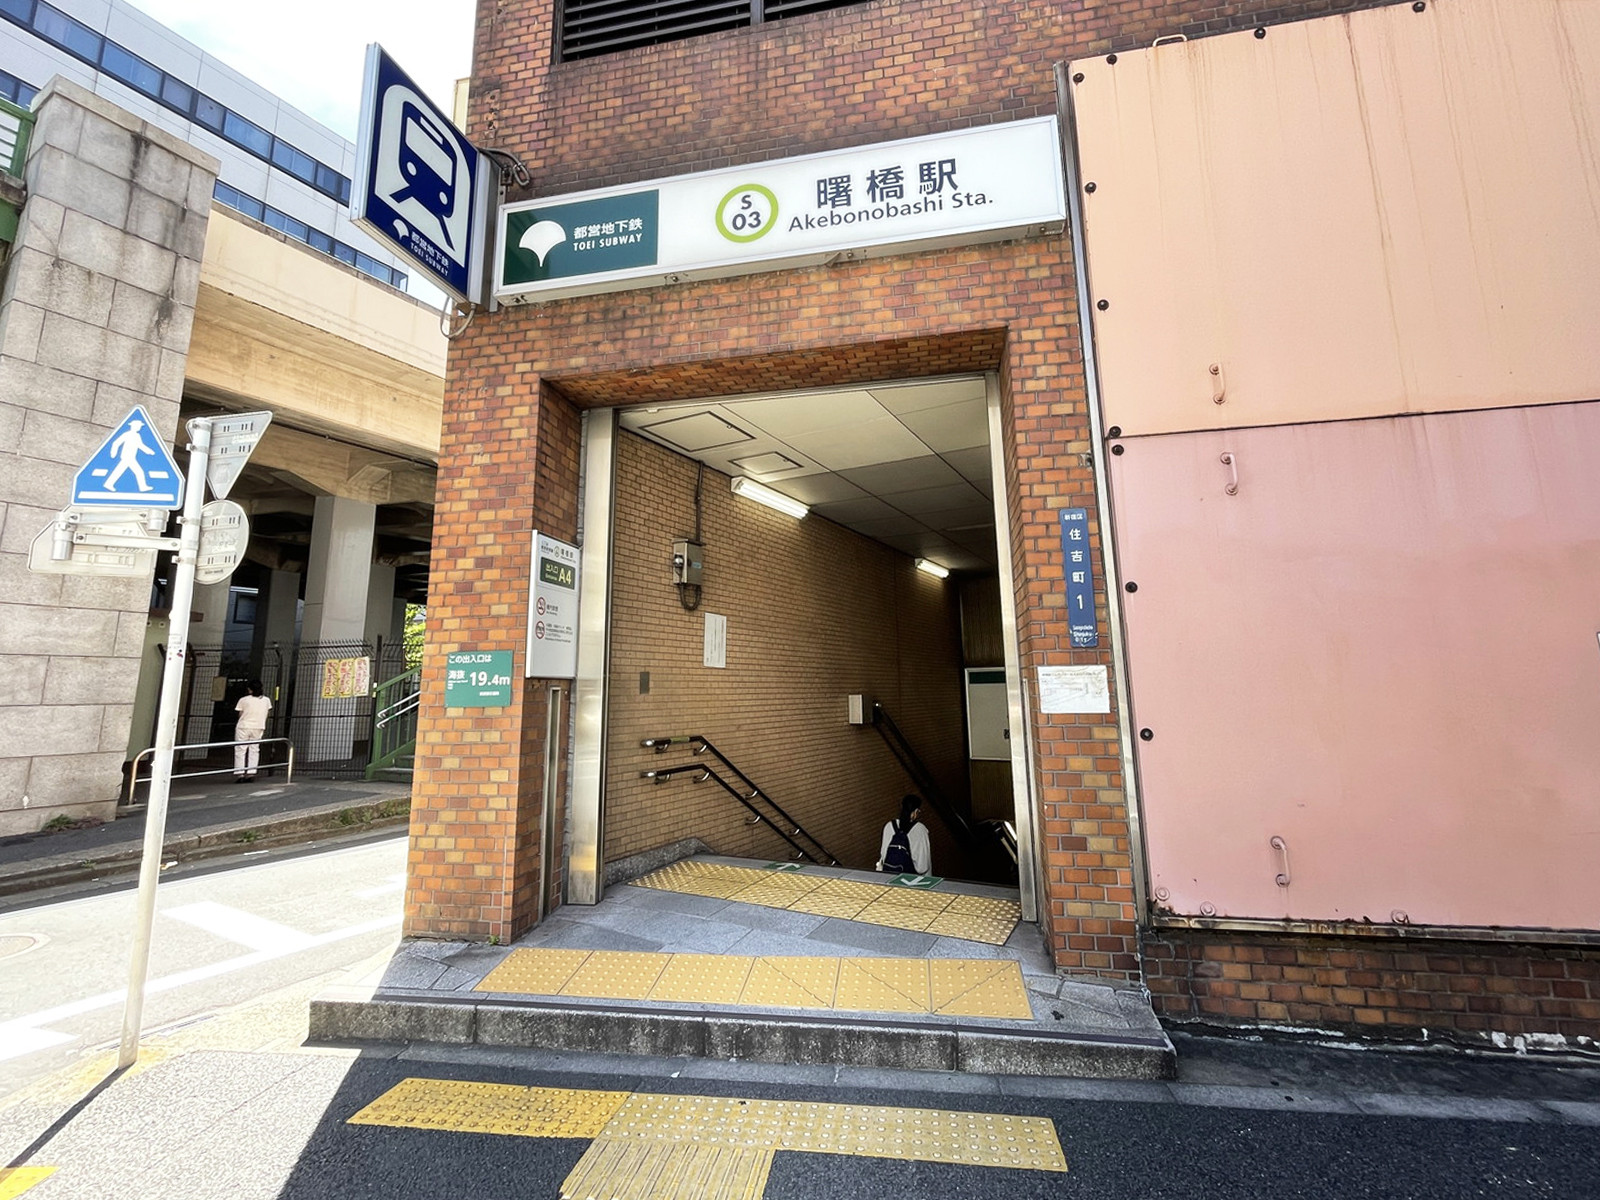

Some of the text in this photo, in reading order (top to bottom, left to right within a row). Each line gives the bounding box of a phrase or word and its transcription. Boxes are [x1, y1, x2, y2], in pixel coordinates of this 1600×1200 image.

[816, 158, 959, 210] 曙橋駅
[740, 194, 753, 210] S
[732, 211, 762, 231] 03
[788, 192, 994, 232] Akebonobashi Sta.
[573, 217, 643, 240] 都営地下鉄
[573, 233, 643, 252] TOEI SUBWAY
[558, 567, 572, 584] A4
[448, 653, 492, 664] この出入口は
[469, 671, 511, 687] 19.4m
